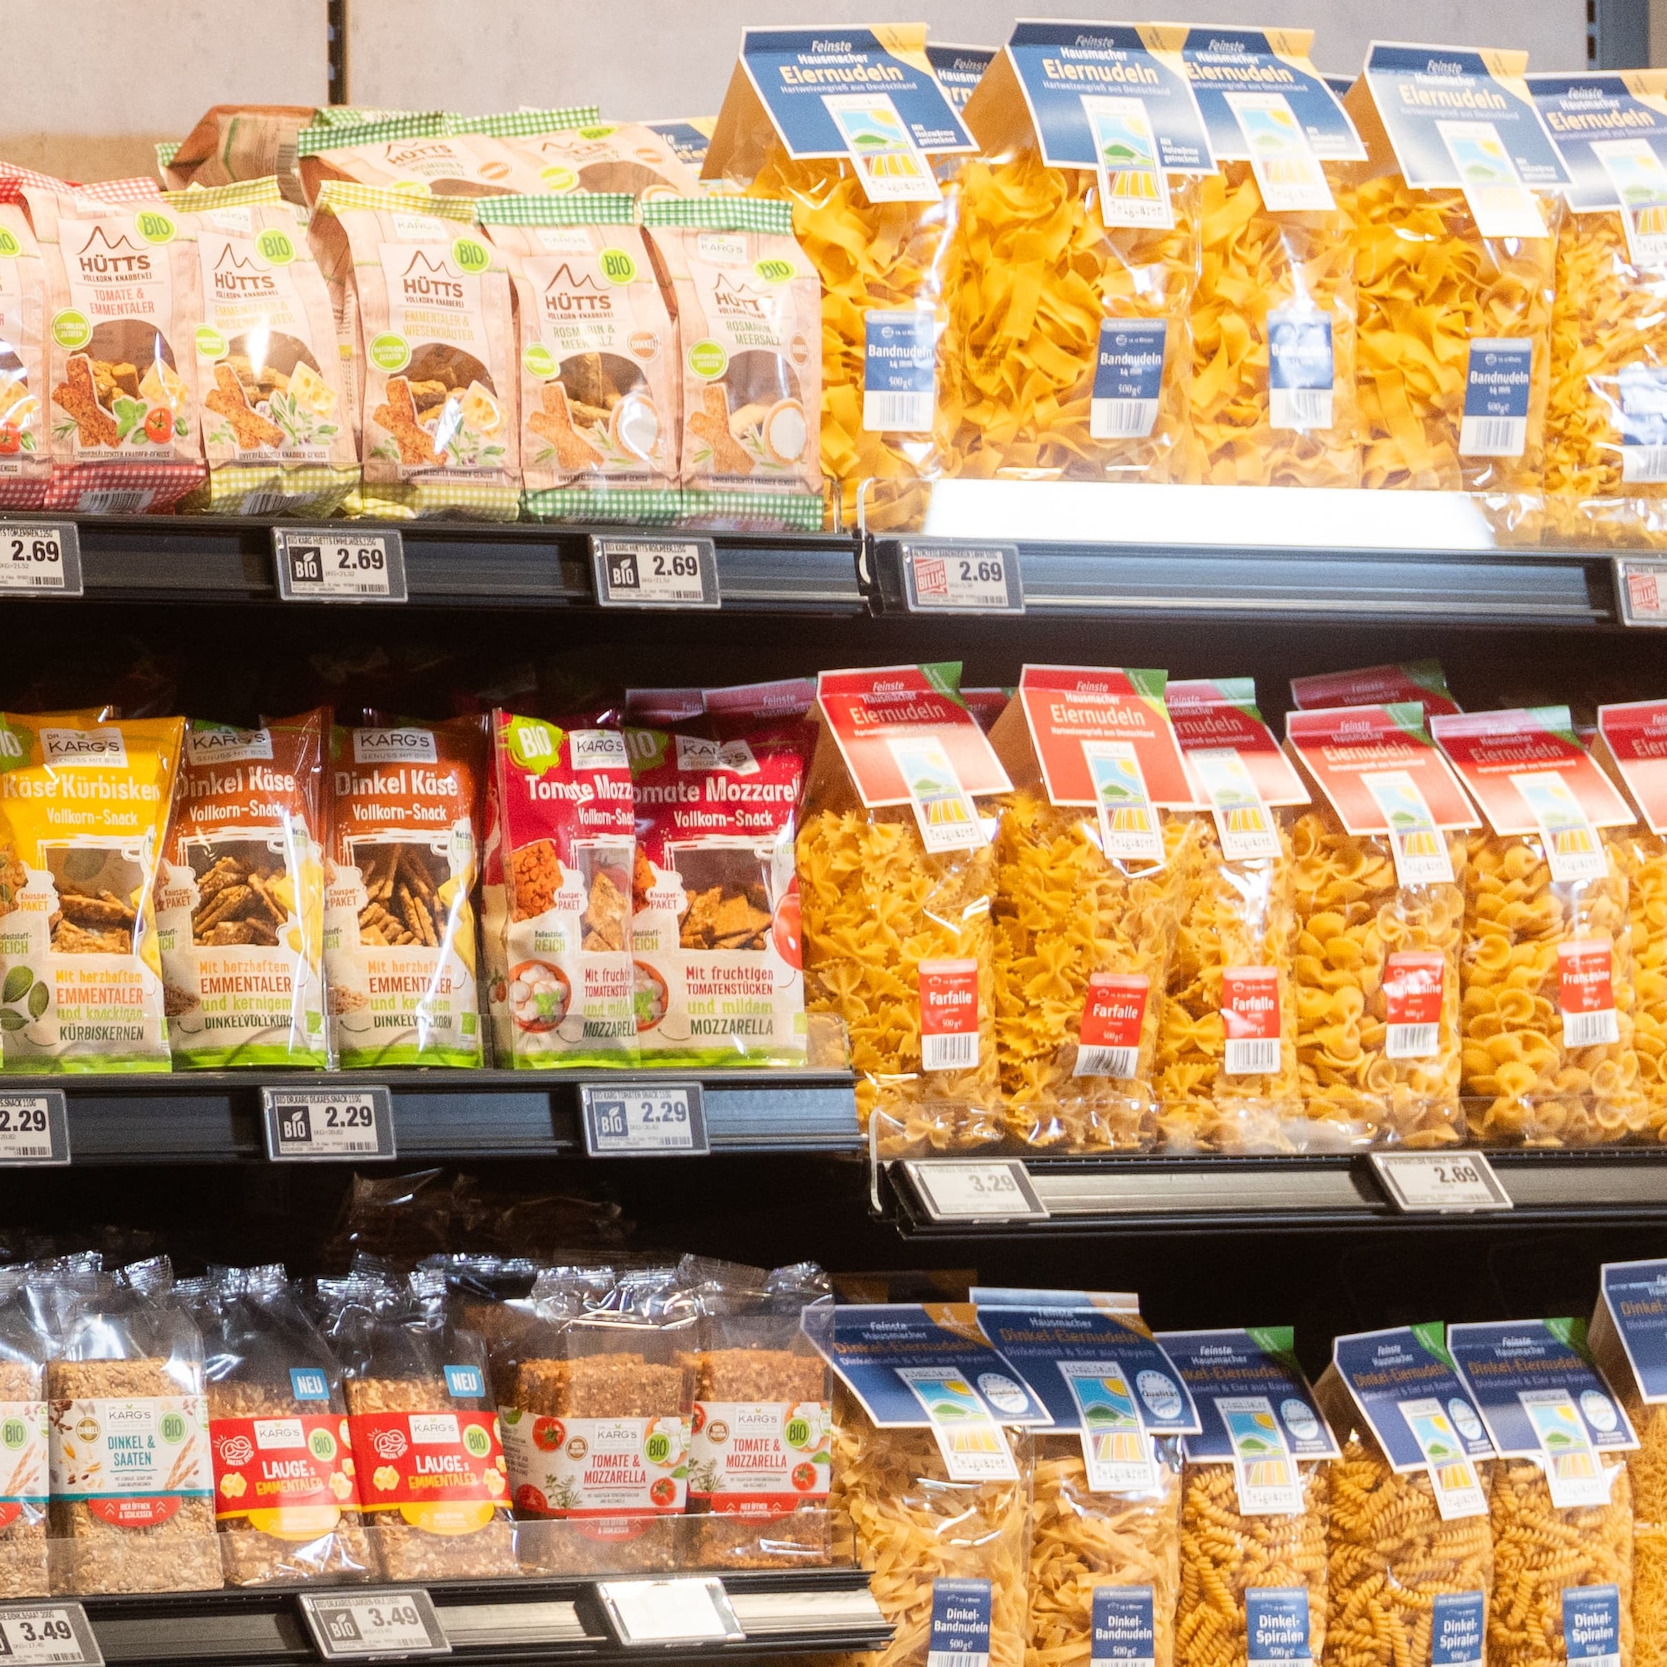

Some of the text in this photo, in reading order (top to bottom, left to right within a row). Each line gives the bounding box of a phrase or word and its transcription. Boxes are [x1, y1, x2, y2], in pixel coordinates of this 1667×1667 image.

[811, 39, 852, 53] Feinste
[798, 52, 868, 65] Hausmacher
[779, 64, 903, 85] Eiernudeln
[1043, 58, 1159, 85] Eiernudeln
[142, 214, 170, 236] BIO
[80, 255, 150, 273] HÜTTS
[95, 289, 126, 302] TOMATE
[545, 293, 611, 311] HÜTTS
[90, 301, 155, 315] EMMENTALER
[868, 344, 933, 359] Bandnudeln
[1470, 370, 1529, 386] Bandnudeln
[11, 540, 59, 562] 2.69
[336, 548, 384, 570] 2.69
[653, 555, 698, 577] 2.69
[959, 561, 1003, 583] 2.69
[1051, 705, 1145, 727] Eiernudeln
[336, 771, 458, 797] Dinkel Käse
[47, 807, 138, 827] Vollkorn-Snack
[353, 802, 446, 822] Vollkorn-Snack
[674, 810, 772, 828] Vollkorn-Snack
[56, 988, 143, 1005] EMMENTALER
[687, 983, 773, 995] TOMATENSTÜCKEN
[929, 989, 972, 1006] Farfalle
[1092, 1003, 1138, 1020] Farfalle
[60, 1025, 144, 1041] KÜRBISKERNEN
[691, 1018, 773, 1035] MOZZARELLA
[325, 1105, 373, 1128] 2.29
[640, 1101, 687, 1123] 2.29
[1433, 1166, 1479, 1183] 2.69
[968, 1174, 1016, 1193] 3.29
[452, 1373, 477, 1391] NEU
[591, 1455, 628, 1468] TOMATE
[409, 1474, 476, 1490] EMMENTALER
[584, 1470, 646, 1484] MOZZARELLA
[368, 1606, 418, 1628] 3.49
[947, 1605, 977, 1620] Dinkel-
[934, 1619, 988, 1634] Bandnudeln
[1258, 1614, 1299, 1629] Dinkel-
[20, 1620, 73, 1642] 3.49
[1256, 1629, 1304, 1644] Spiralen
